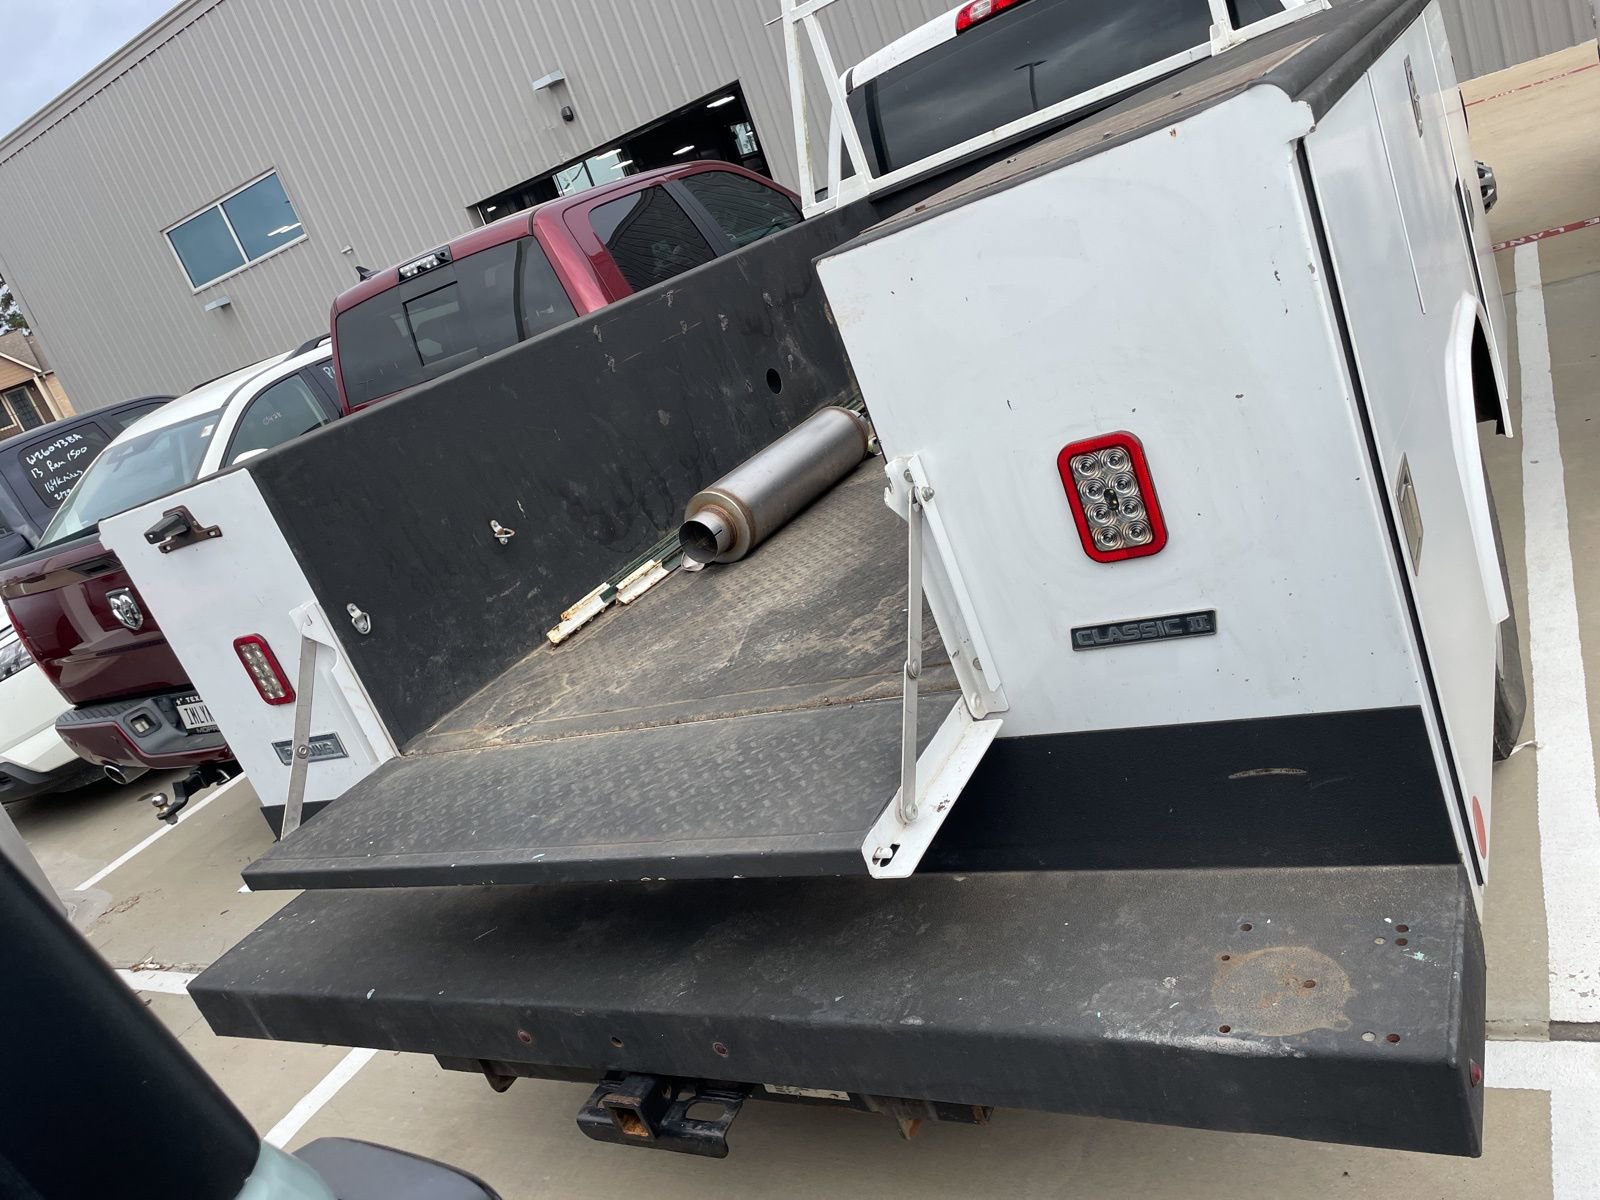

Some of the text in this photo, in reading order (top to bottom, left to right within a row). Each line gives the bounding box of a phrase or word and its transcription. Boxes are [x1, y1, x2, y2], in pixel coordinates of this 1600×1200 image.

[31, 467, 44, 479] 13
[46, 460, 66, 473] Ram
[1075, 614, 1211, 646] CLASSIC II
